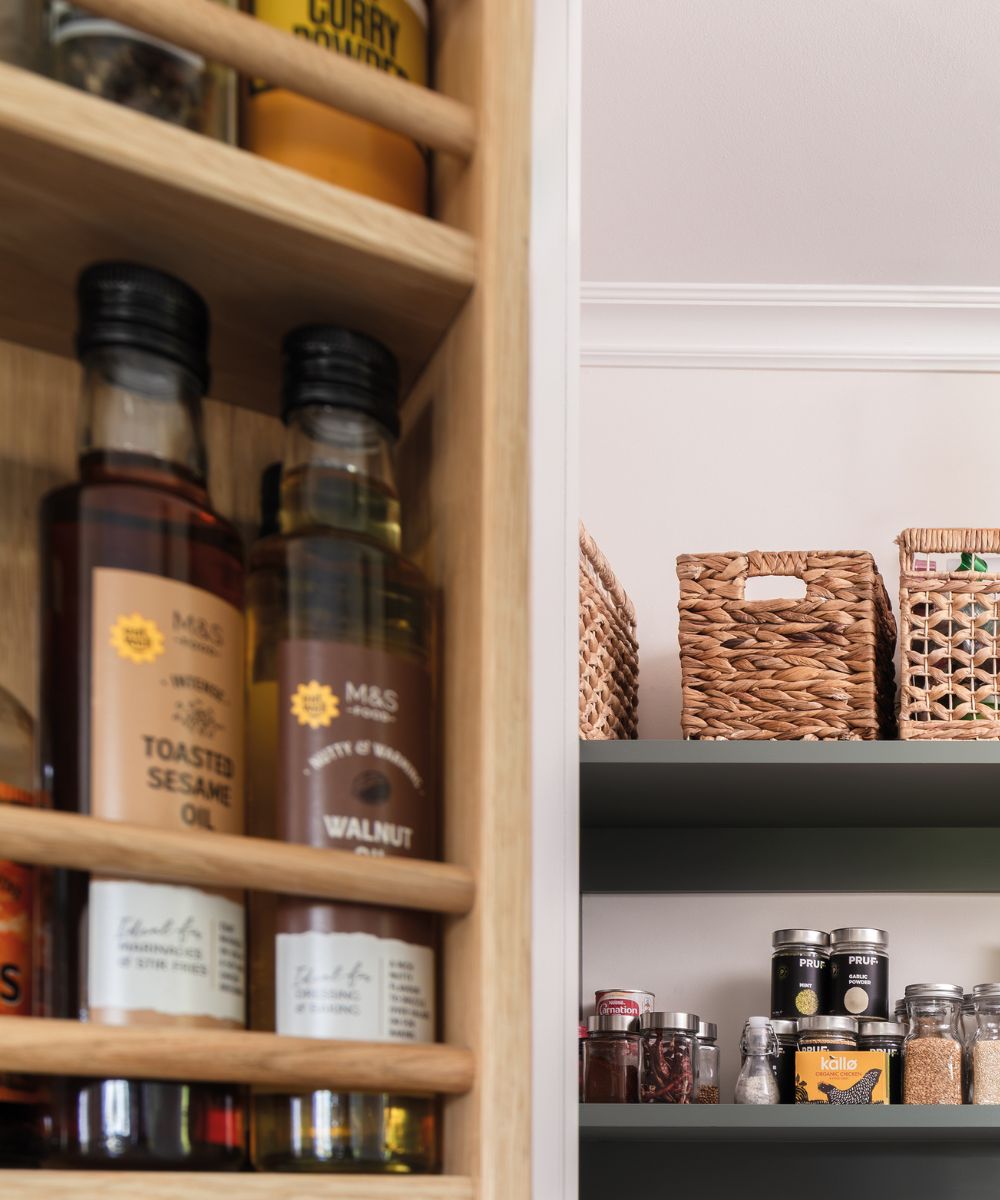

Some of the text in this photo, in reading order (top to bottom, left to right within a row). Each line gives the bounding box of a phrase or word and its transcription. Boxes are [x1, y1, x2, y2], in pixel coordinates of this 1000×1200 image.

[345, 681, 399, 713] M&S
[141, 734, 235, 780] TOASTED
[147, 767, 231, 808] SESAME
[181, 803, 214, 832] OIL
[322, 814, 414, 849] WALNUT
[600, 1002, 638, 1016] Carnation
